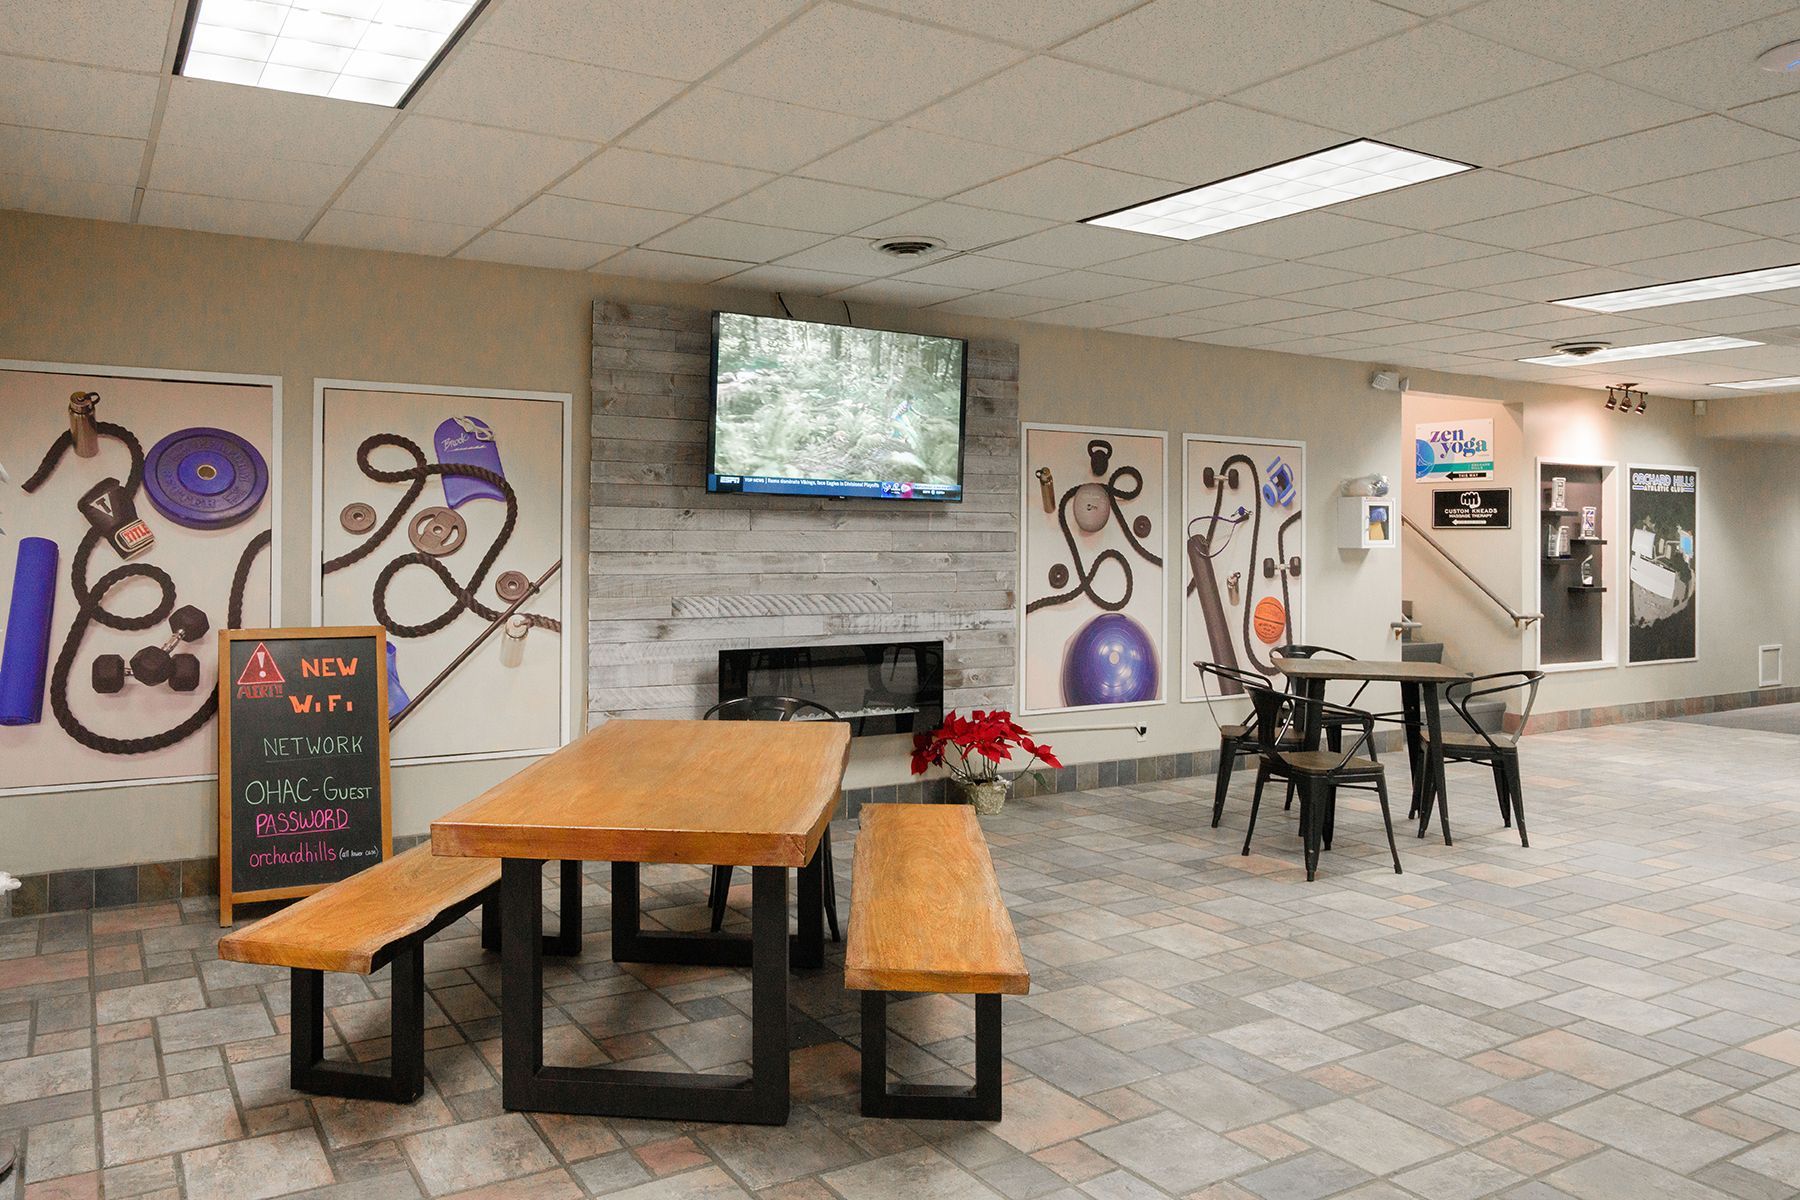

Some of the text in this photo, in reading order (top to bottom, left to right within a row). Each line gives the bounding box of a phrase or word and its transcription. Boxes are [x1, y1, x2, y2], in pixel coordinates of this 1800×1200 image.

[1430, 429, 1464, 443] zen
[1440, 437, 1487, 458] yoga
[1632, 472, 1694, 488] ORCHARD HILLS
[123, 523, 151, 543] TITLE
[302, 657, 358, 678] NEW
[263, 735, 363, 757] NETWORK
[256, 808, 349, 836] PASSWORD
[250, 841, 337, 868] orchardhills
